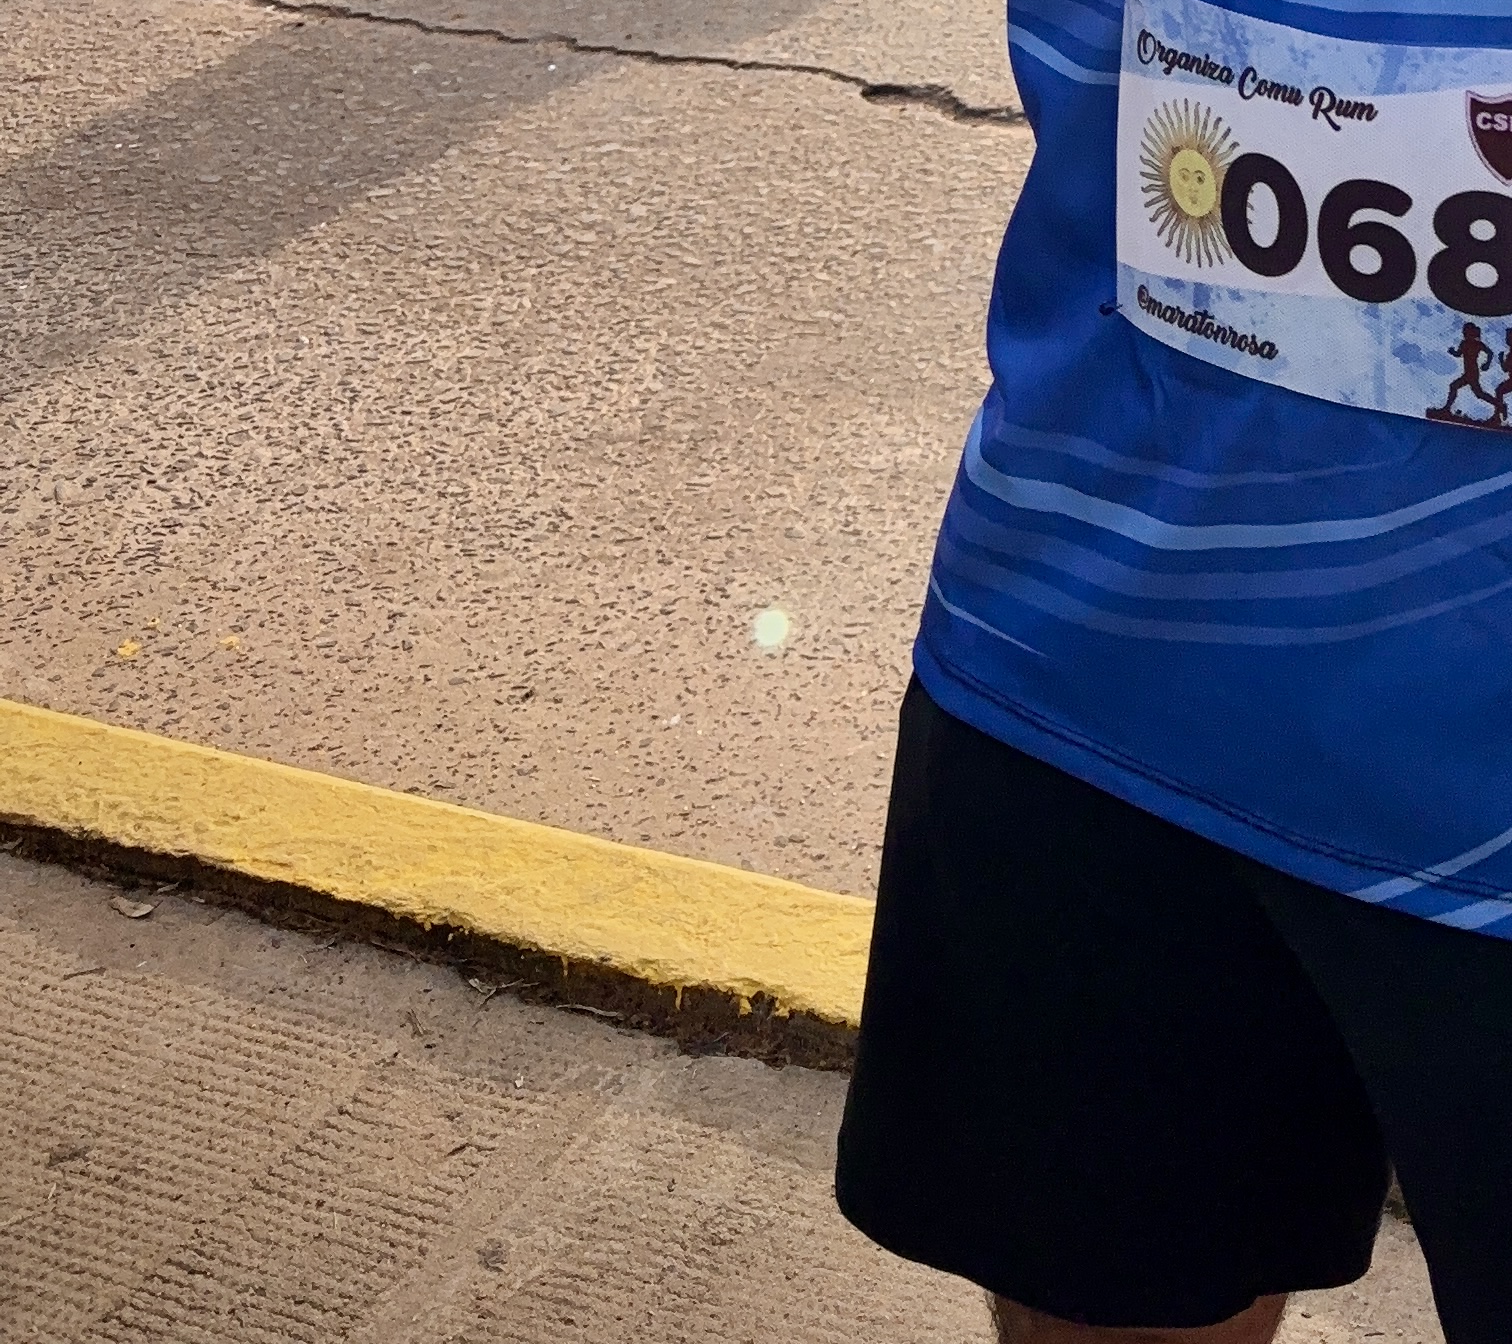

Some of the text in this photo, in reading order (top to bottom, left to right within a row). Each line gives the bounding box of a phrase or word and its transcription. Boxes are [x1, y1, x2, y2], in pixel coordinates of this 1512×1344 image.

[1136, 27, 1236, 86] Organiza
[1237, 65, 1305, 107] Comu
[1136, 283, 1280, 361] @maratonrosa
